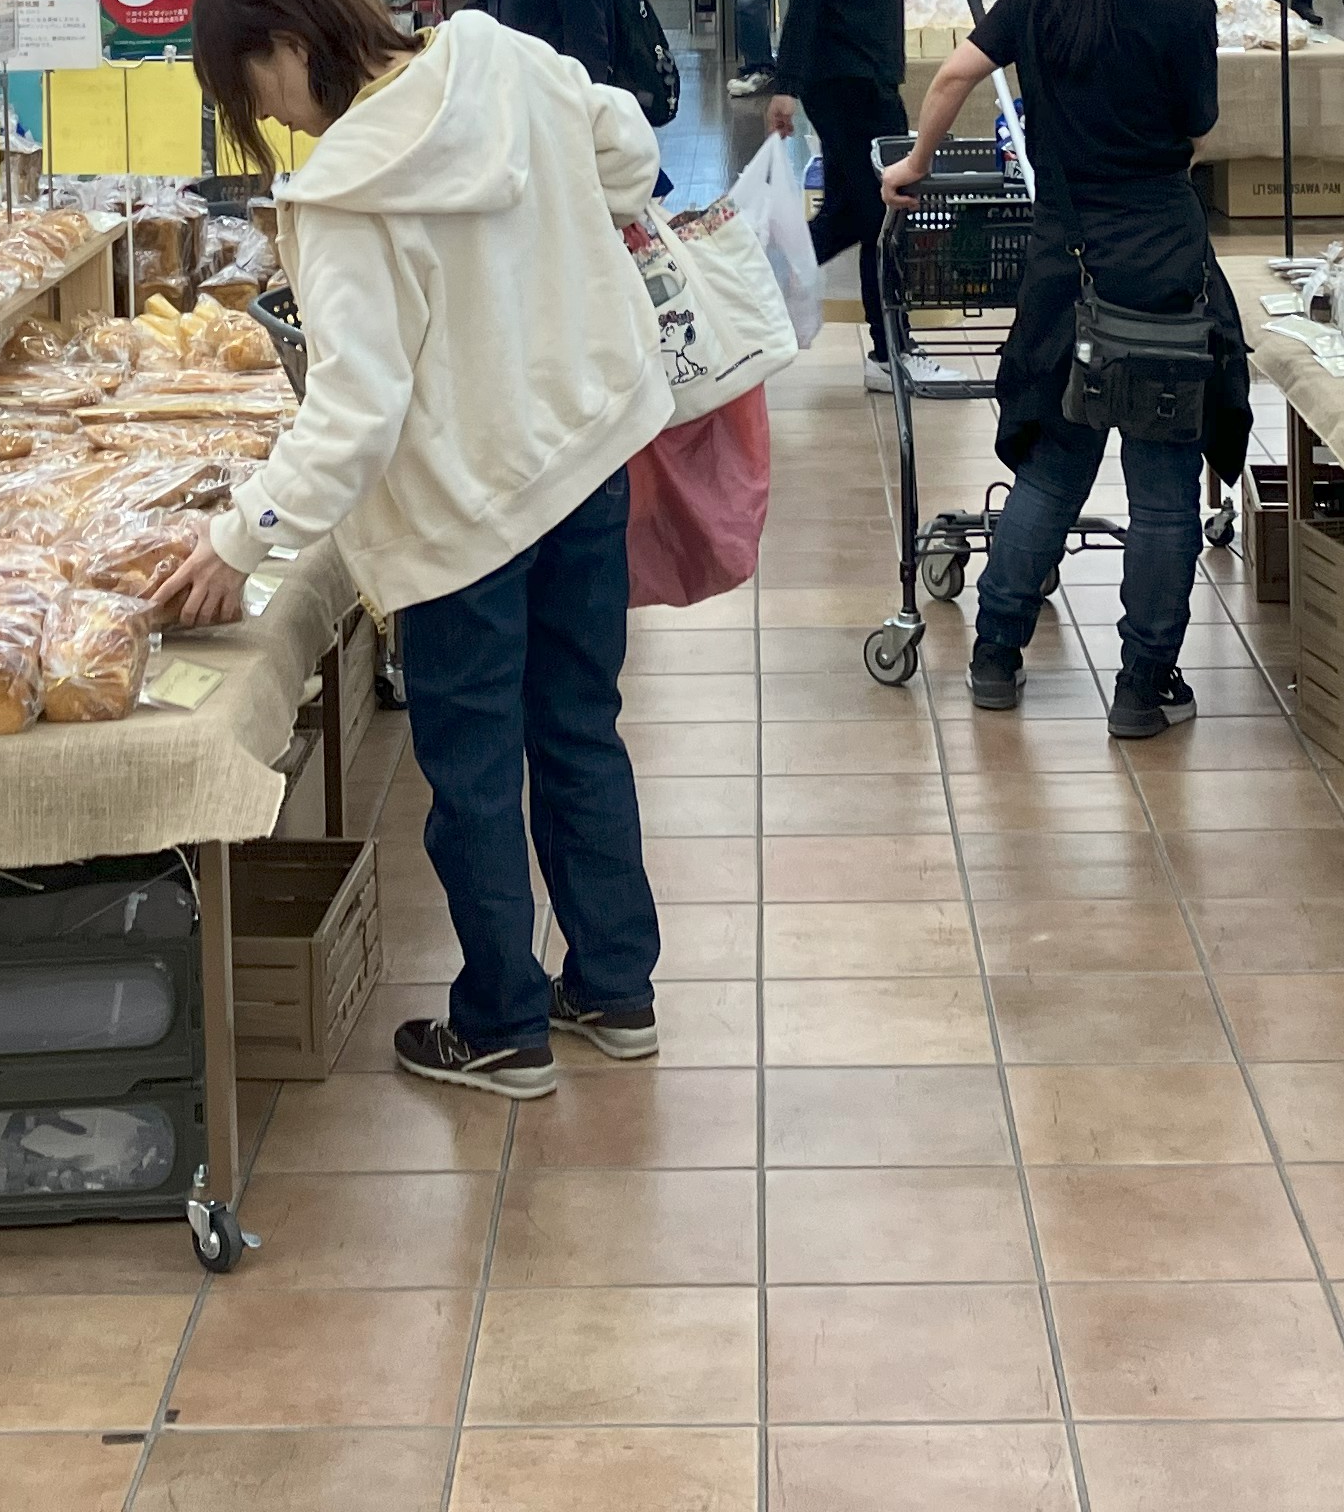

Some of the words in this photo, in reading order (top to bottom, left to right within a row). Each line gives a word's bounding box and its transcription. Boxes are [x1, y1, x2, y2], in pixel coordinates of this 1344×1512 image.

[1268, 183, 1320, 195] SHISAWA
[1322, 183, 1341, 194] PAN
[987, 206, 1034, 218] CAIN
